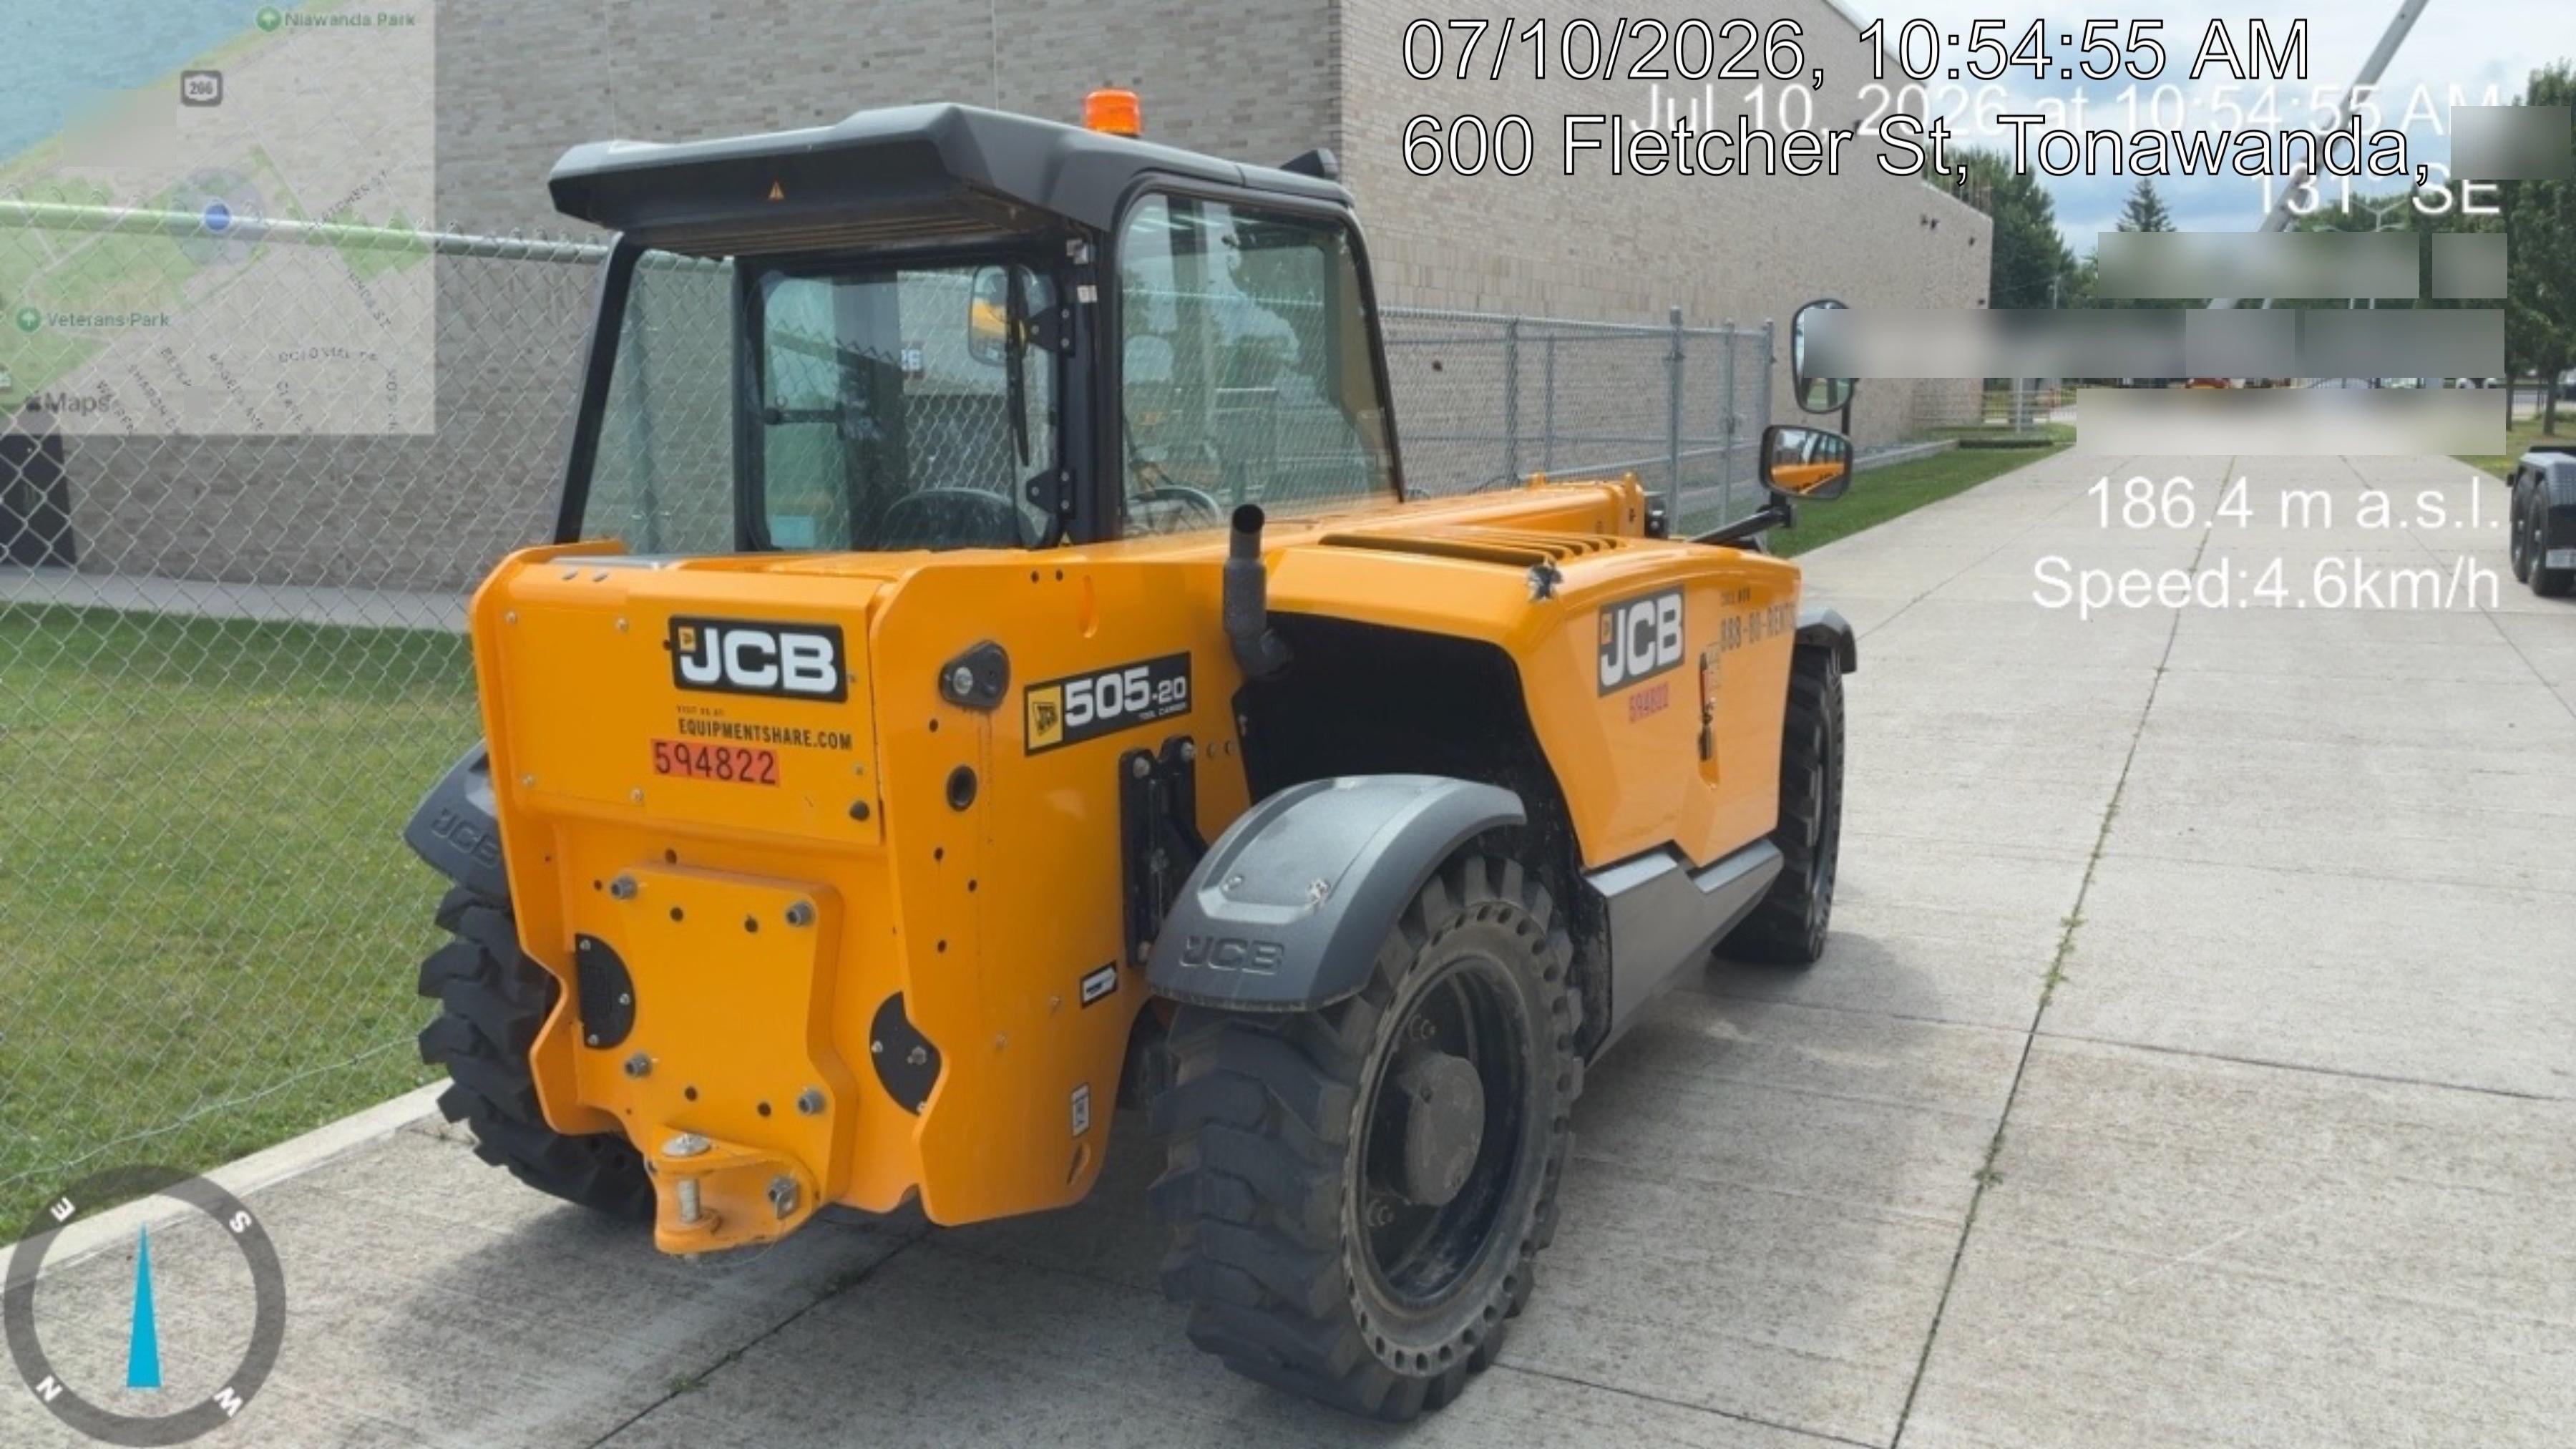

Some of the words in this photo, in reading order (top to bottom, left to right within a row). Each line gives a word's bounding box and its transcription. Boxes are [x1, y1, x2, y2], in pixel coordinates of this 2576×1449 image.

[680, 627, 837, 693] JCB
[1600, 592, 1682, 687] JCB
[1064, 665, 1187, 727] 505-20
[654, 741, 776, 786] 594822
[678, 718, 852, 750] EQUIPMENTSHARE.COM
[429, 806, 500, 869] JCB
[1179, 935, 1284, 975] JCB
